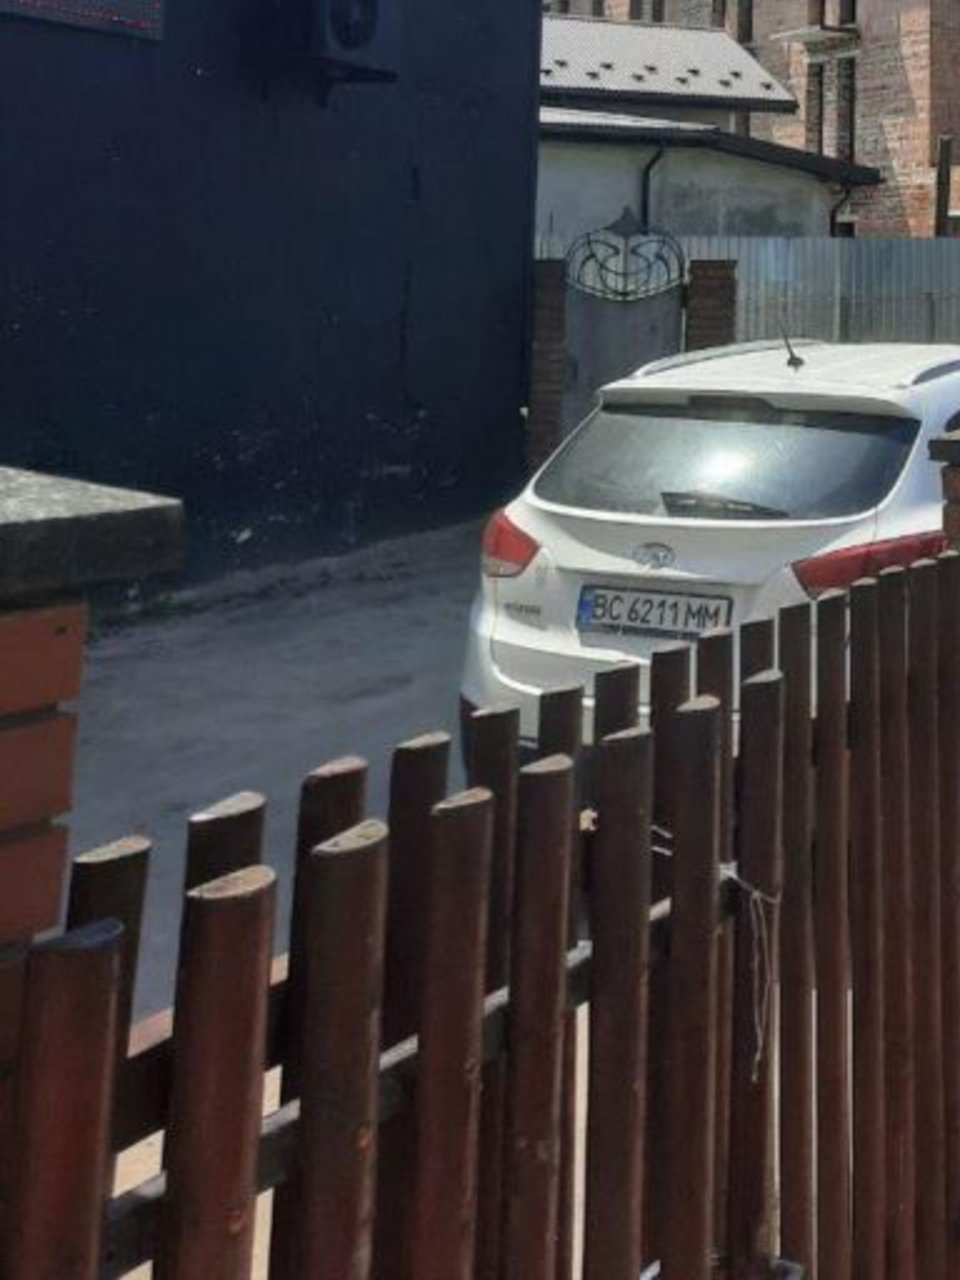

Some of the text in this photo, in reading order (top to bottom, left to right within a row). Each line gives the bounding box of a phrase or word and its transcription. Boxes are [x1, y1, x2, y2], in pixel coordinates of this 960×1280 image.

[593, 594, 721, 629] BC 6211 MM
